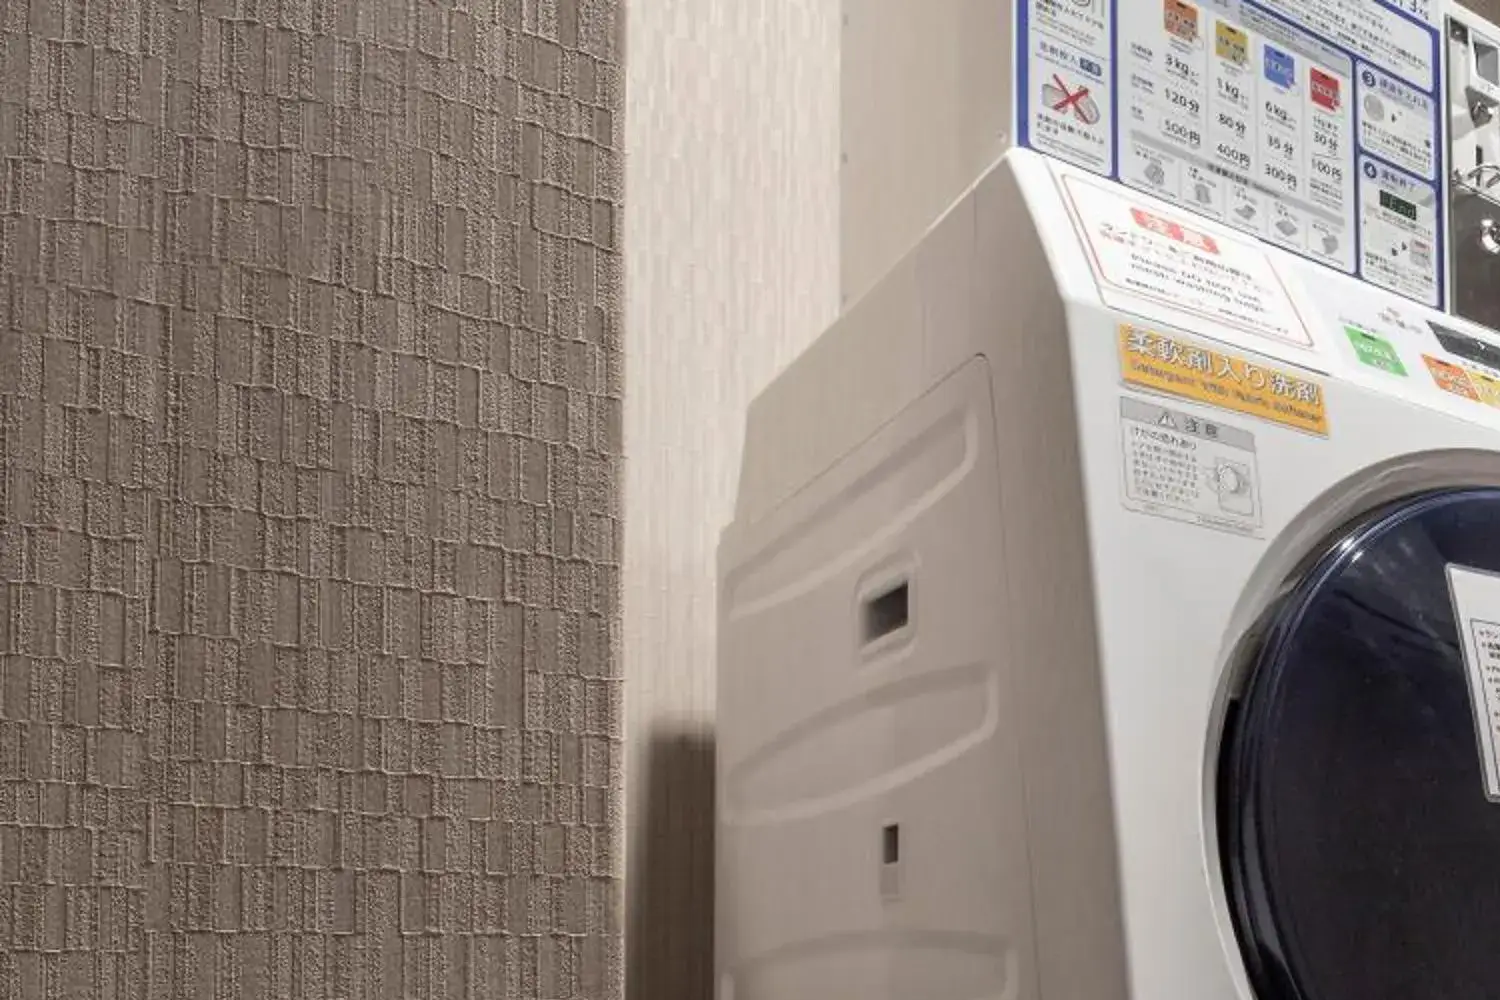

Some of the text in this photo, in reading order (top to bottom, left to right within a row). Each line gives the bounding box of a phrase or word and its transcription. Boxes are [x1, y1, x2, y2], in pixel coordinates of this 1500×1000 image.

[1126, 326, 1320, 405] 柔軟剤入り洗剤
